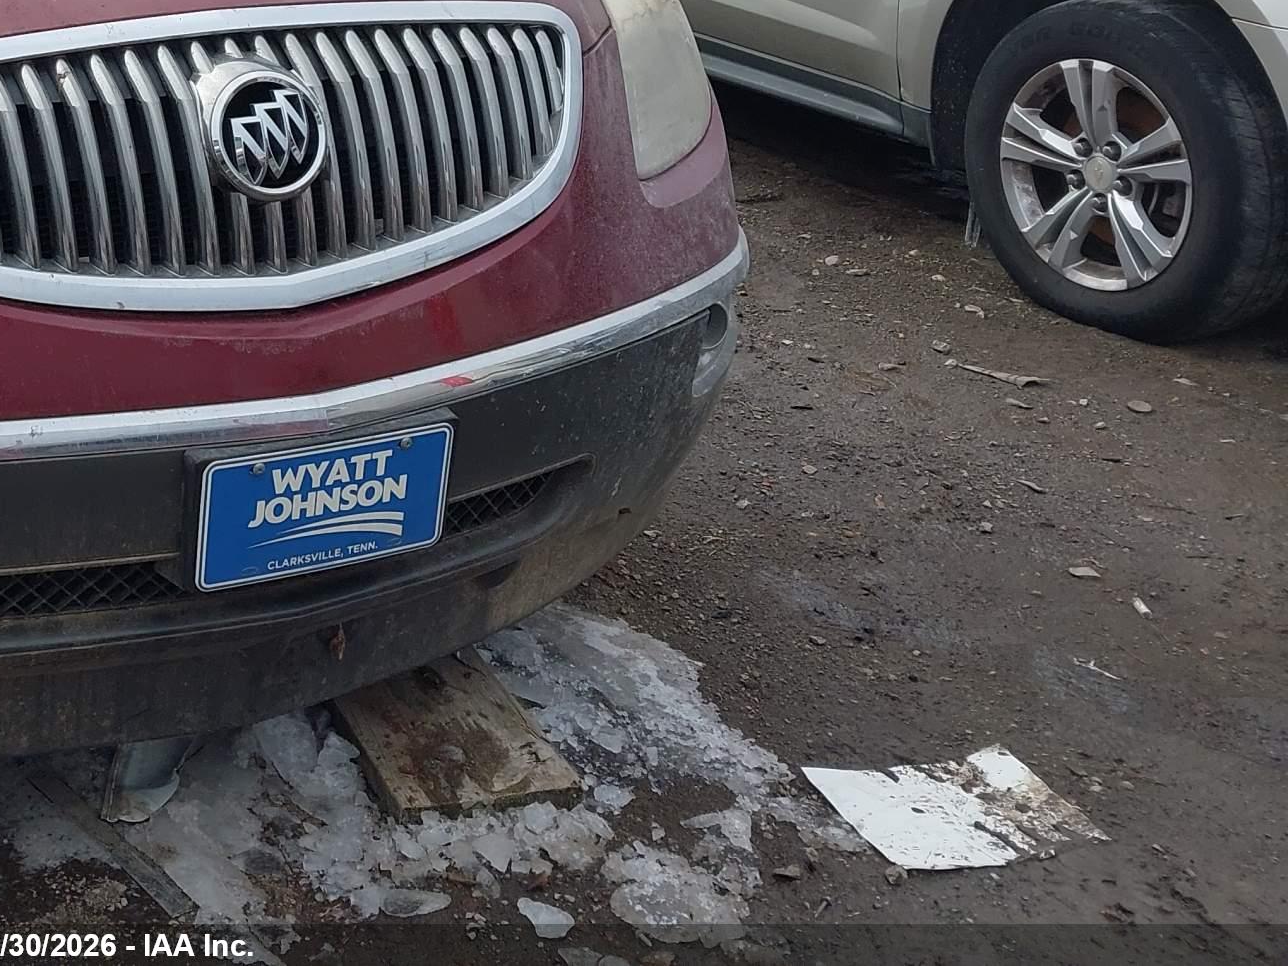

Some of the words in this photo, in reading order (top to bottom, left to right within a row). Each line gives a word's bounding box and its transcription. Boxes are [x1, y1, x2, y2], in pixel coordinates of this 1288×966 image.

[272, 449, 393, 494] WYATT
[247, 474, 407, 528] JOHNSON
[267, 547, 344, 571] CLARKSVILLE,
[347, 540, 378, 555] TENN.
